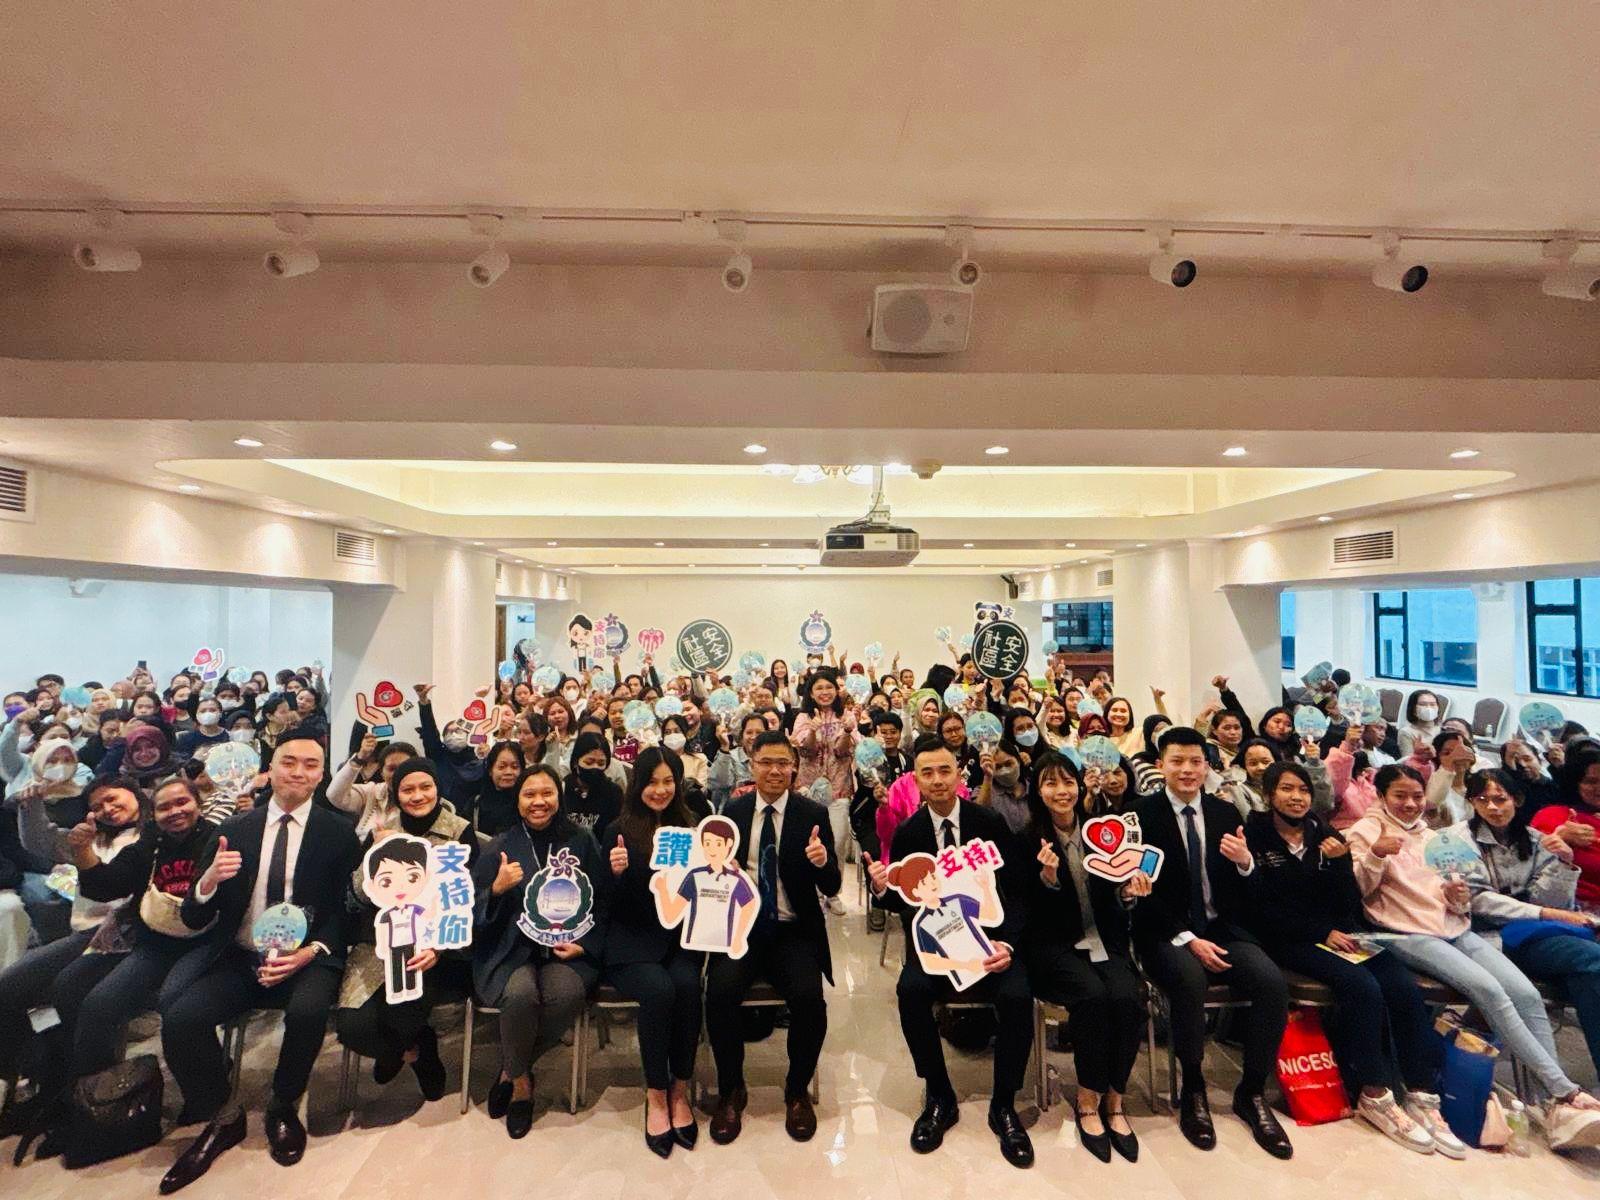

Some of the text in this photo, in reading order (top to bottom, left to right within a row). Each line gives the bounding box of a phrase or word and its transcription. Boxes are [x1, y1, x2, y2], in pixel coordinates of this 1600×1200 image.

[655, 831, 692, 867] 讚
[435, 844, 470, 945] 支持你
